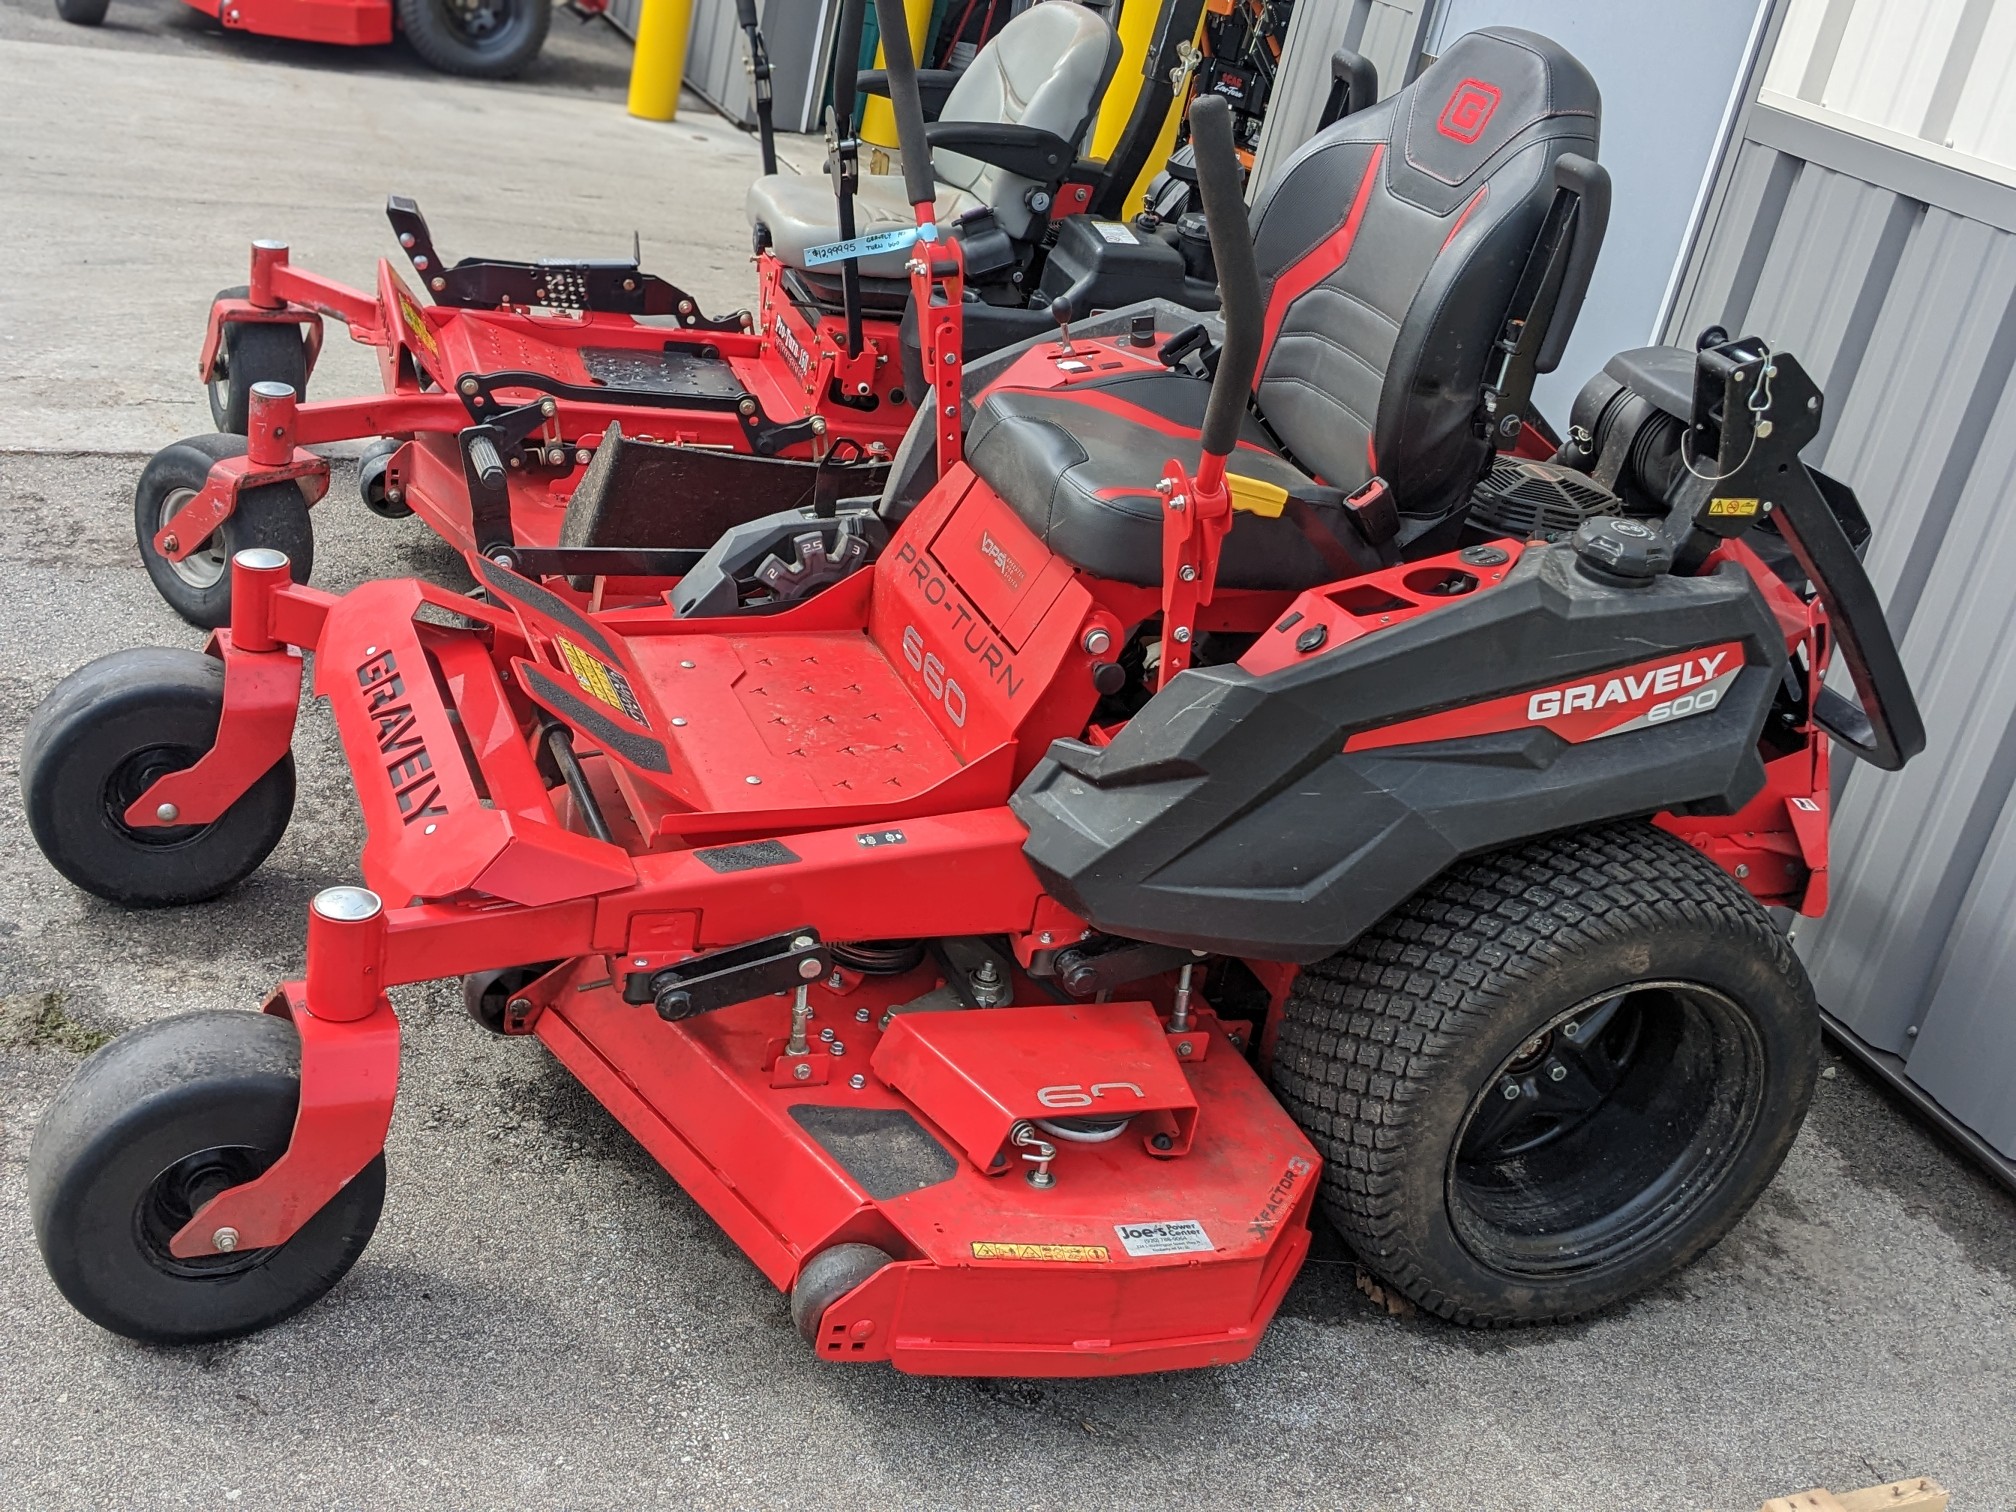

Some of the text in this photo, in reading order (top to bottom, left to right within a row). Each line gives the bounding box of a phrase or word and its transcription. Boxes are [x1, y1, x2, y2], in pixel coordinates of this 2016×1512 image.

[1451, 91, 1488, 130] G
[802, 540, 823, 553] 2.5
[852, 544, 861, 555] 3
[767, 568, 778, 579] 2
[895, 541, 1024, 699] PRO-TURN
[903, 625, 967, 728] 660
[1527, 651, 1727, 721] GRAVELY
[1647, 689, 1718, 722] 600
[356, 649, 449, 826] GRAVELY
[1166, 1223, 1196, 1231] Power
[1169, 1229, 1201, 1237] Center
